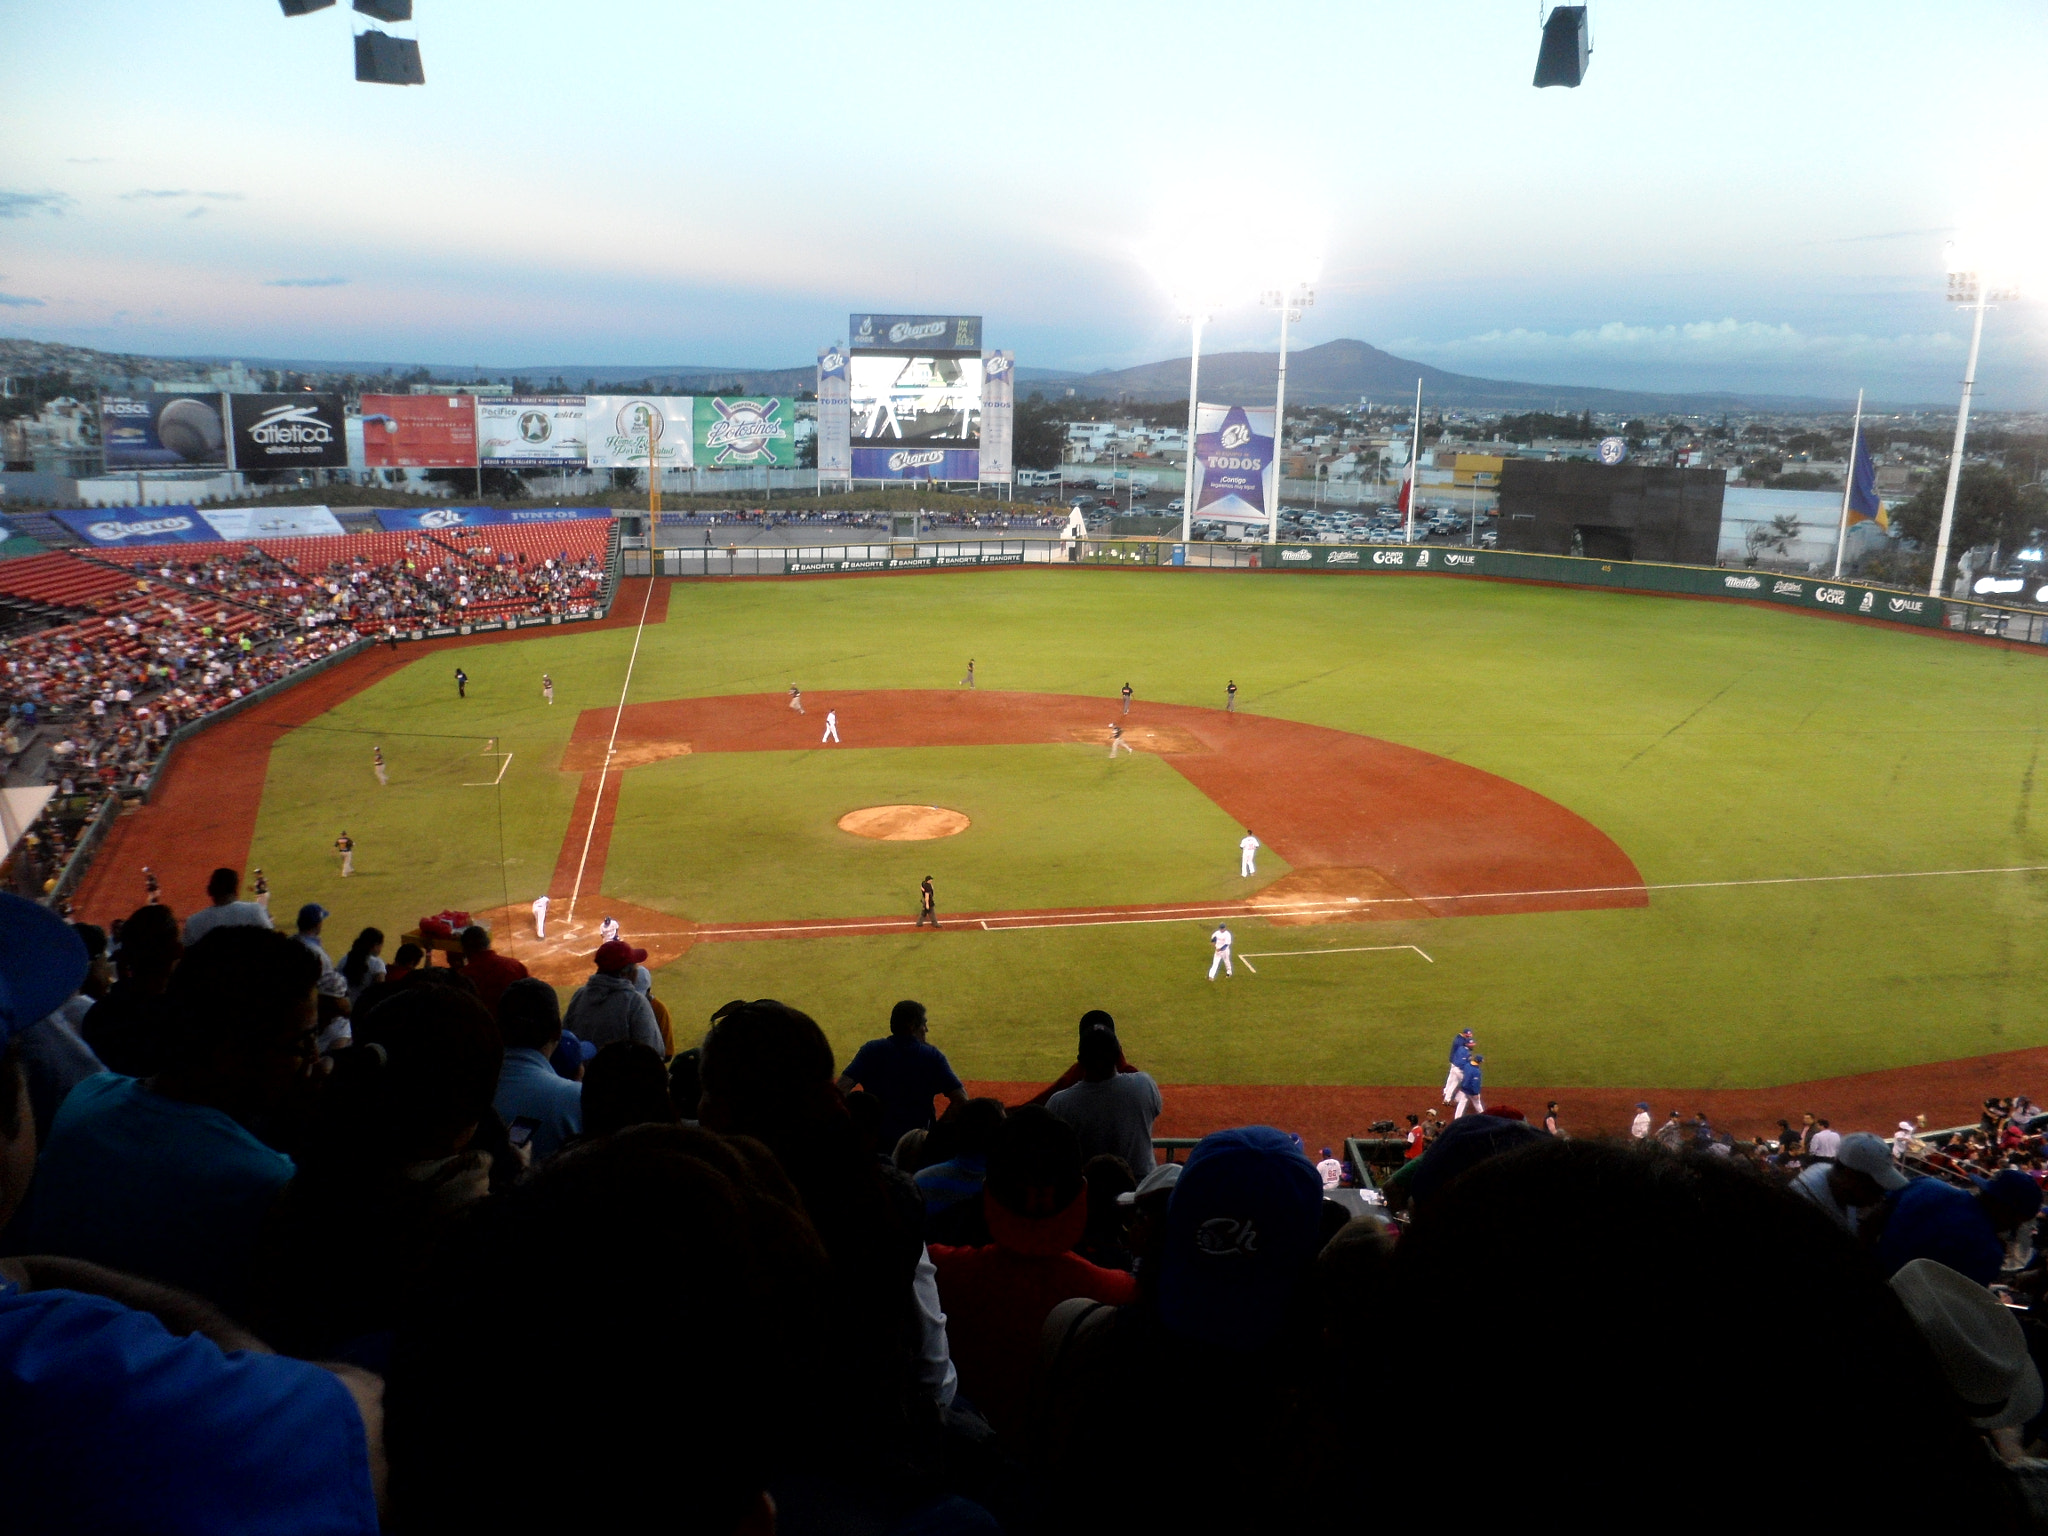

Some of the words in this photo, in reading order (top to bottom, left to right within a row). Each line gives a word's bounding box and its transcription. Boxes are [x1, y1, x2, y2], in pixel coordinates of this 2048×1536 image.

[889, 321, 947, 343] Charros
[822, 353, 845, 372] Ch
[986, 356, 1009, 375] Ch
[708, 418, 781, 447] Potosinos
[1221, 424, 1250, 449] Ch
[1603, 444, 1619, 456] 34
[888, 450, 945, 471] Charros
[1207, 456, 1261, 471] TODOS
[420, 509, 465, 529] Ch
[511, 511, 578, 521] JUNTOS
[87, 516, 194, 541] Charros
[1385, 556, 1404, 565] CHG
[1445, 554, 1475, 564] VALUE
[1826, 594, 1845, 605] CHG
[1891, 598, 1923, 612] VALUE
[1196, 1218, 1259, 1255] Ch
